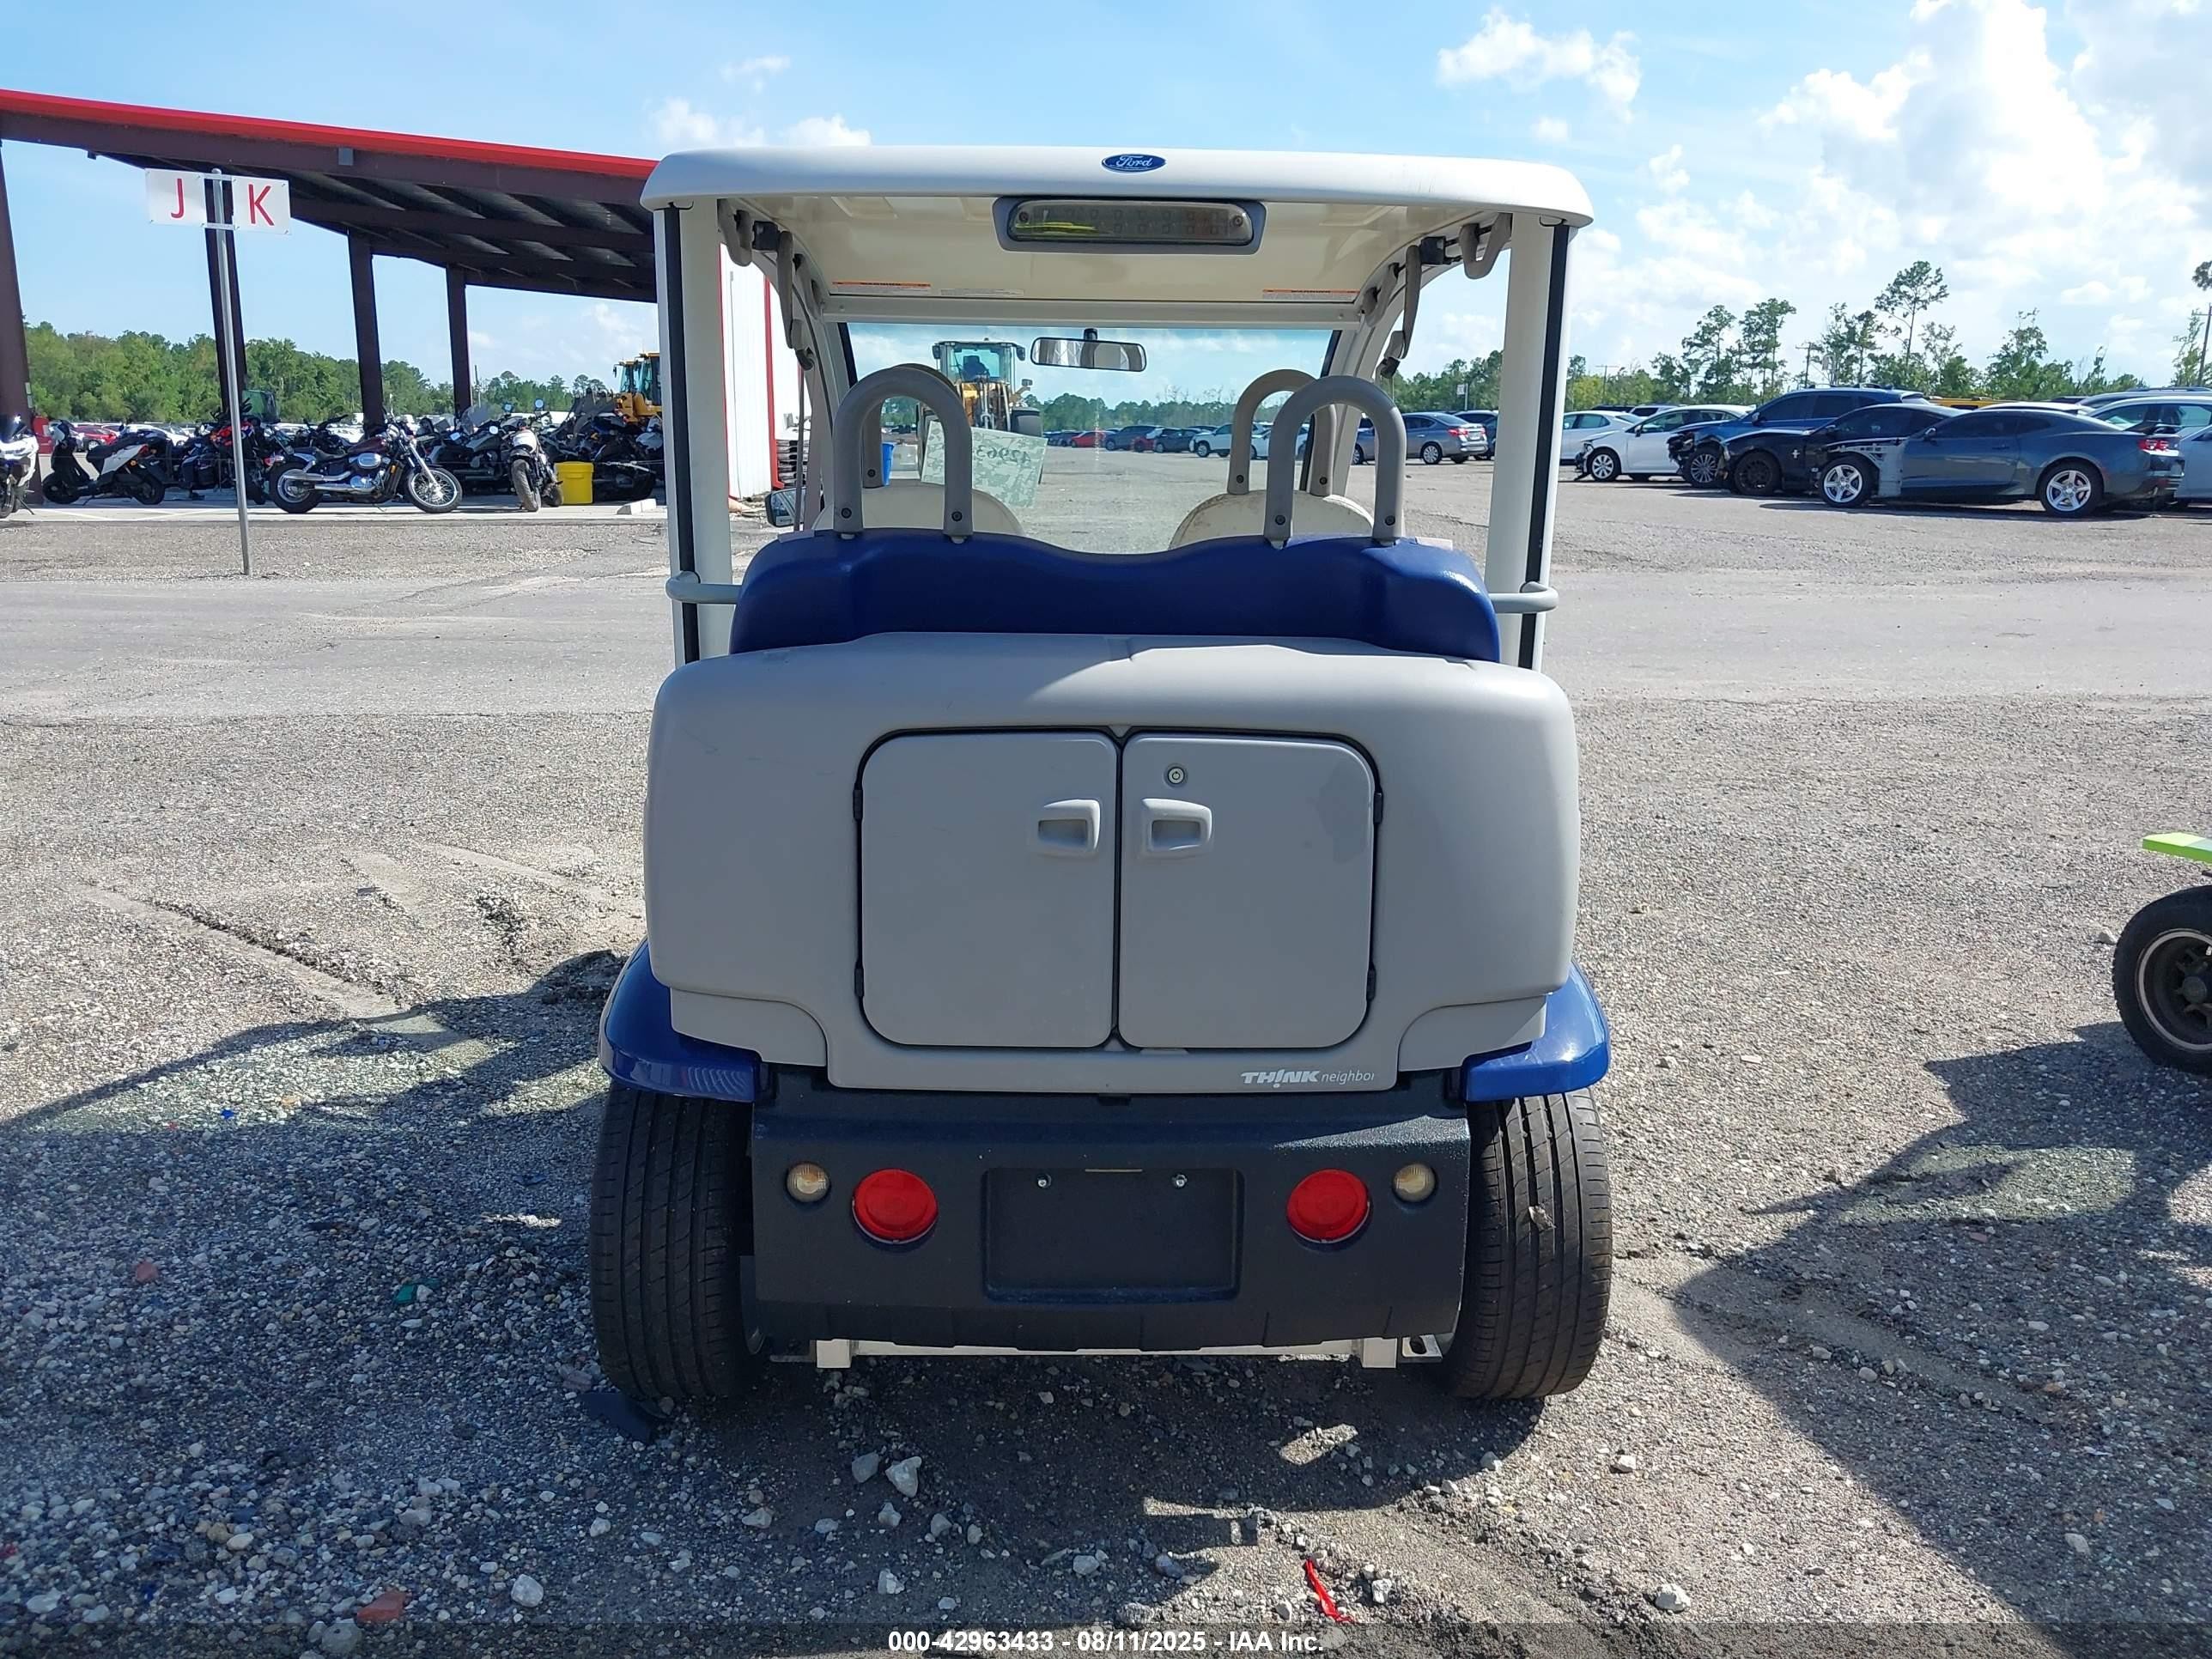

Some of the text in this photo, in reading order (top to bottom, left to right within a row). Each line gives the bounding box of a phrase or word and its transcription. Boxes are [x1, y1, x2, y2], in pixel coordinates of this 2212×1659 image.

[1116, 155, 1153, 167] Ford
[171, 178, 185, 219] J
[248, 184, 275, 226] K
